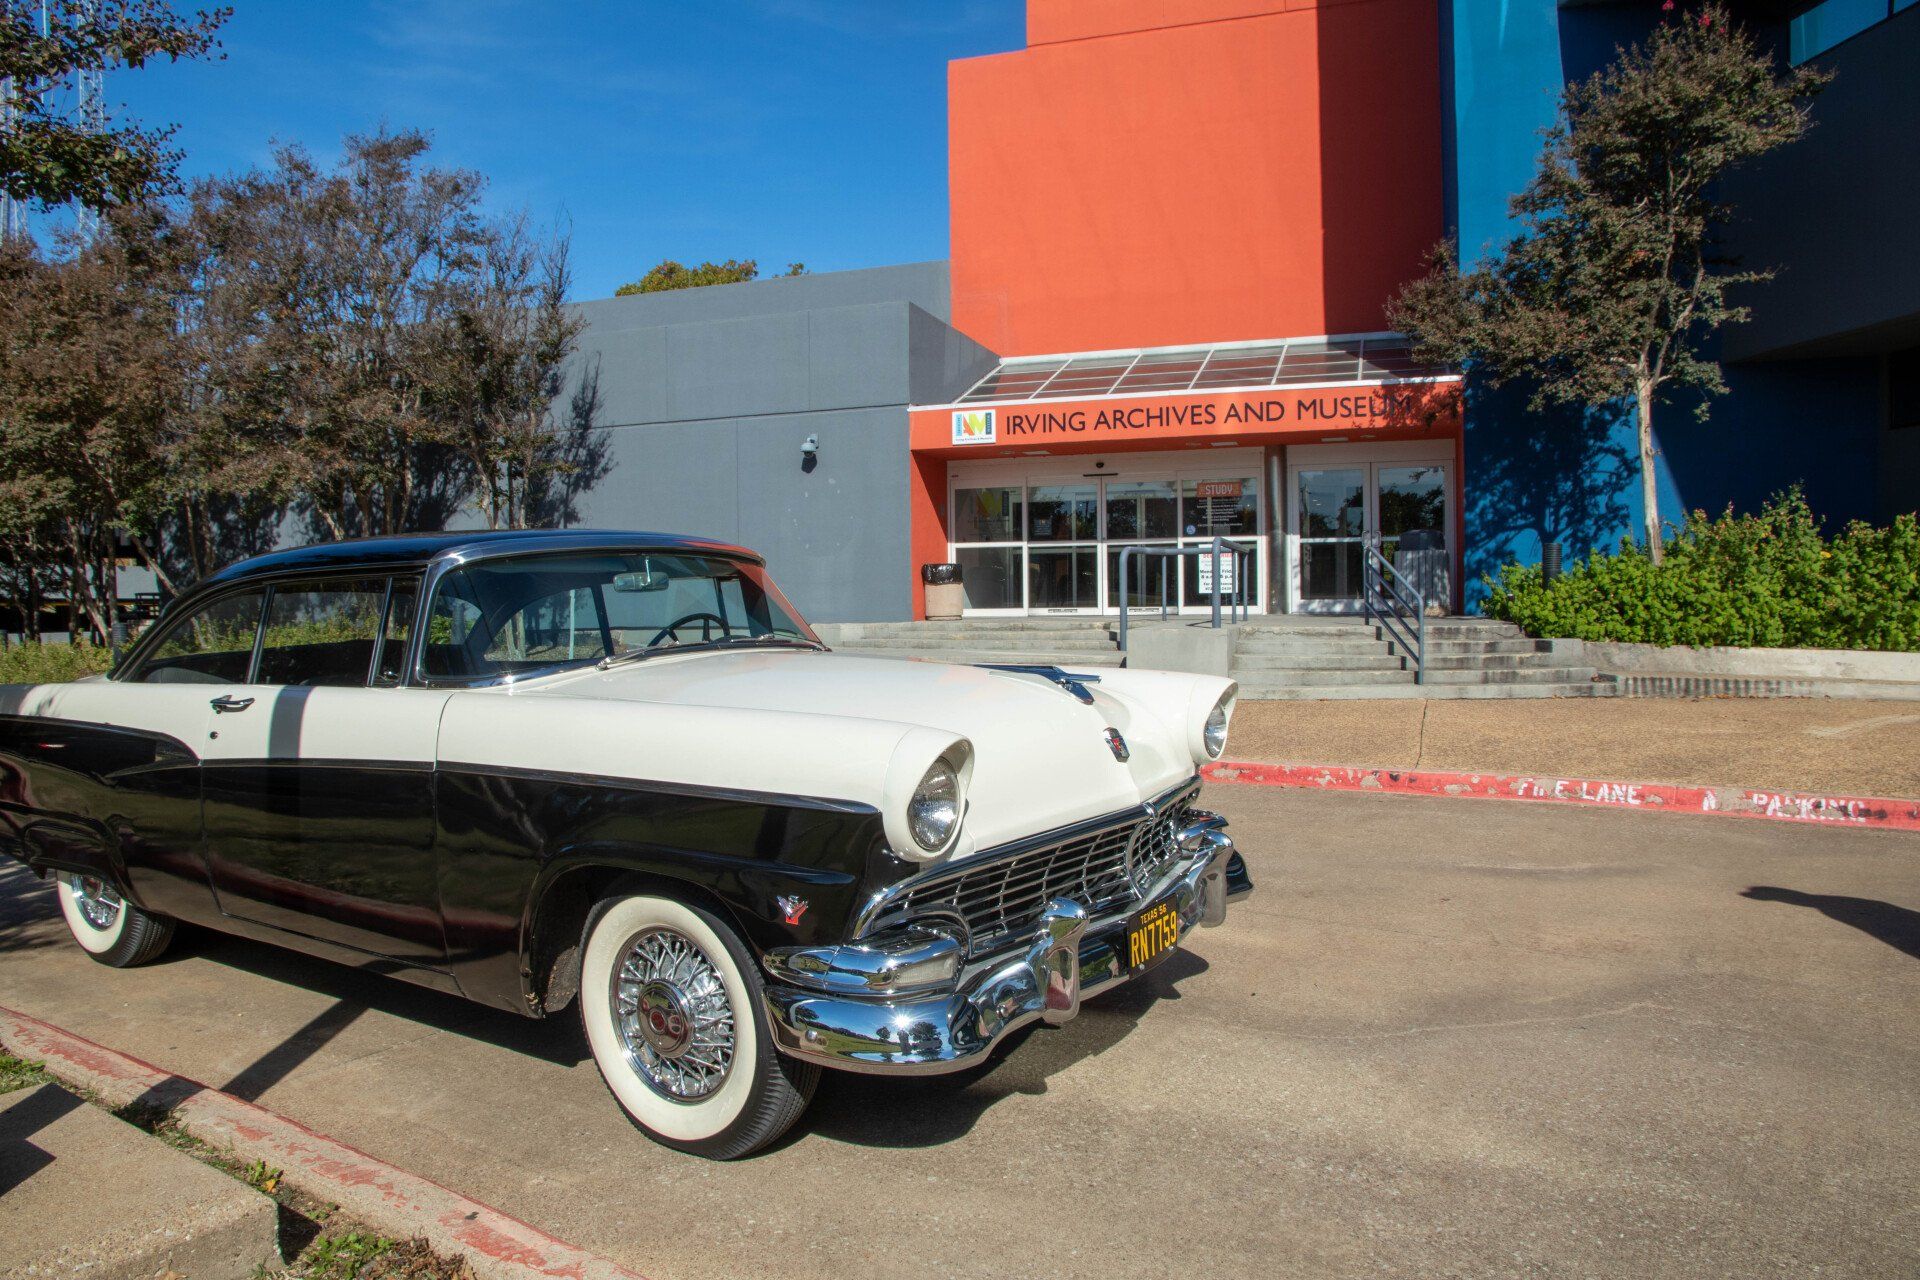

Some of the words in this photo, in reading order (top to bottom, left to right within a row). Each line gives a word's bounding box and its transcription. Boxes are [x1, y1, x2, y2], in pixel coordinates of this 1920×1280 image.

[1006, 411, 1086, 435] IRVING
[1094, 404, 1216, 430] ARCHIVES
[1224, 400, 1285, 424] AND
[1297, 395, 1411, 421] MUSEUM
[1205, 484, 1233, 495] STUDY
[1581, 781, 1642, 805] LANE
[1140, 908, 1158, 925] TEXAS
[1131, 910, 1177, 968] RN7759
